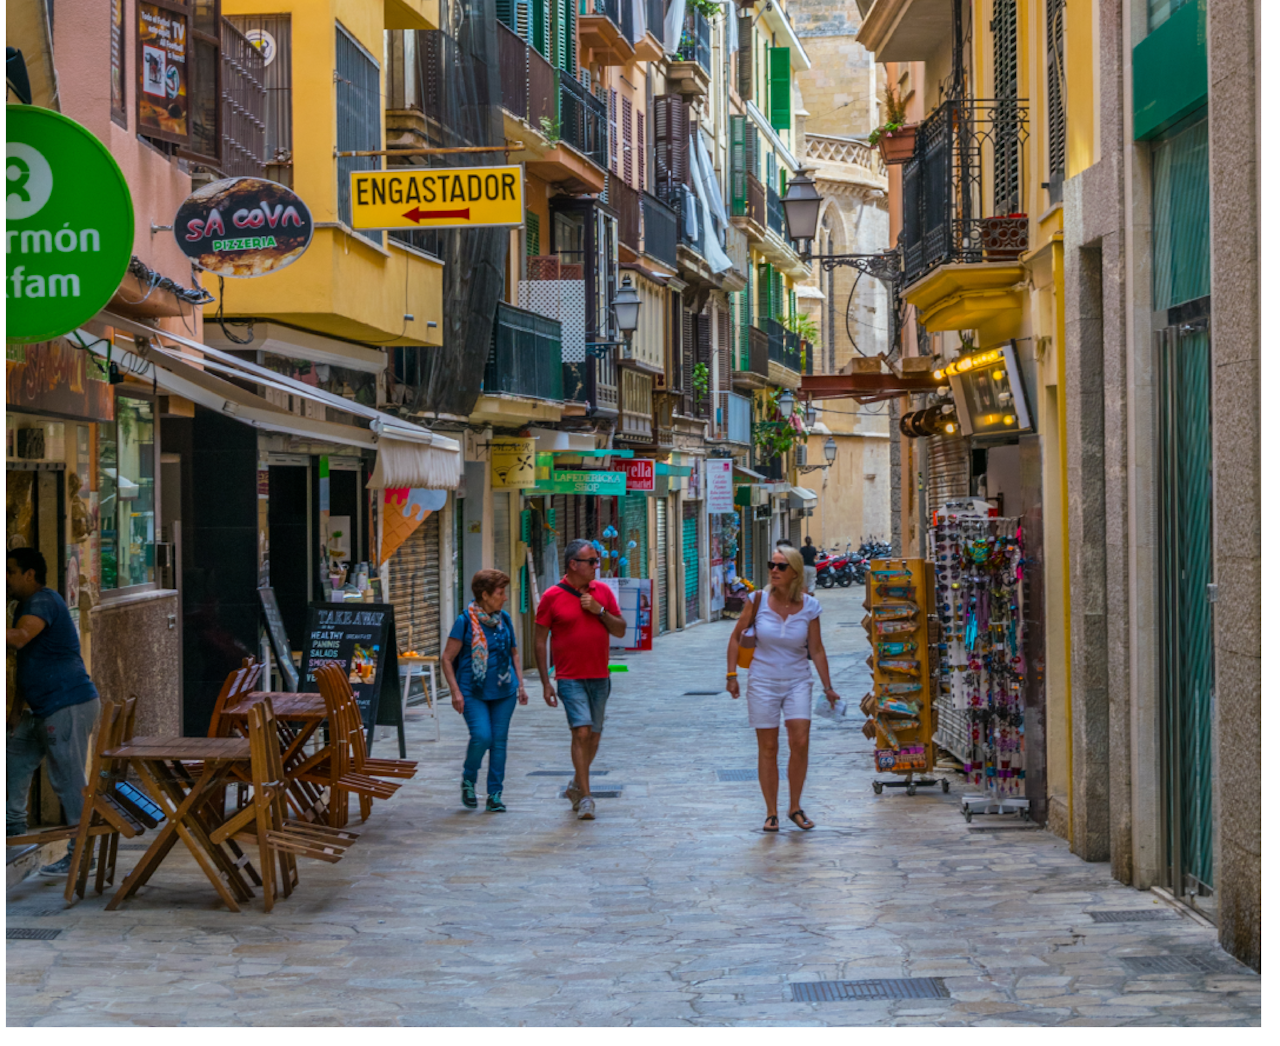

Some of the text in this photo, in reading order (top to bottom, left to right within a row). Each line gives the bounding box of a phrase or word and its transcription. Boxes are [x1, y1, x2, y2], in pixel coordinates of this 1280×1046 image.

[171, 20, 186, 41] TV
[356, 173, 516, 206] ENGASTADOR
[185, 207, 226, 242] SA
[212, 235, 278, 252] PIZZERIA
[574, 483, 600, 493] SHOP
[318, 610, 385, 626] TAKE AWAY
[310, 631, 344, 640] HEALTHY
[309, 649, 338, 658] SALADS
